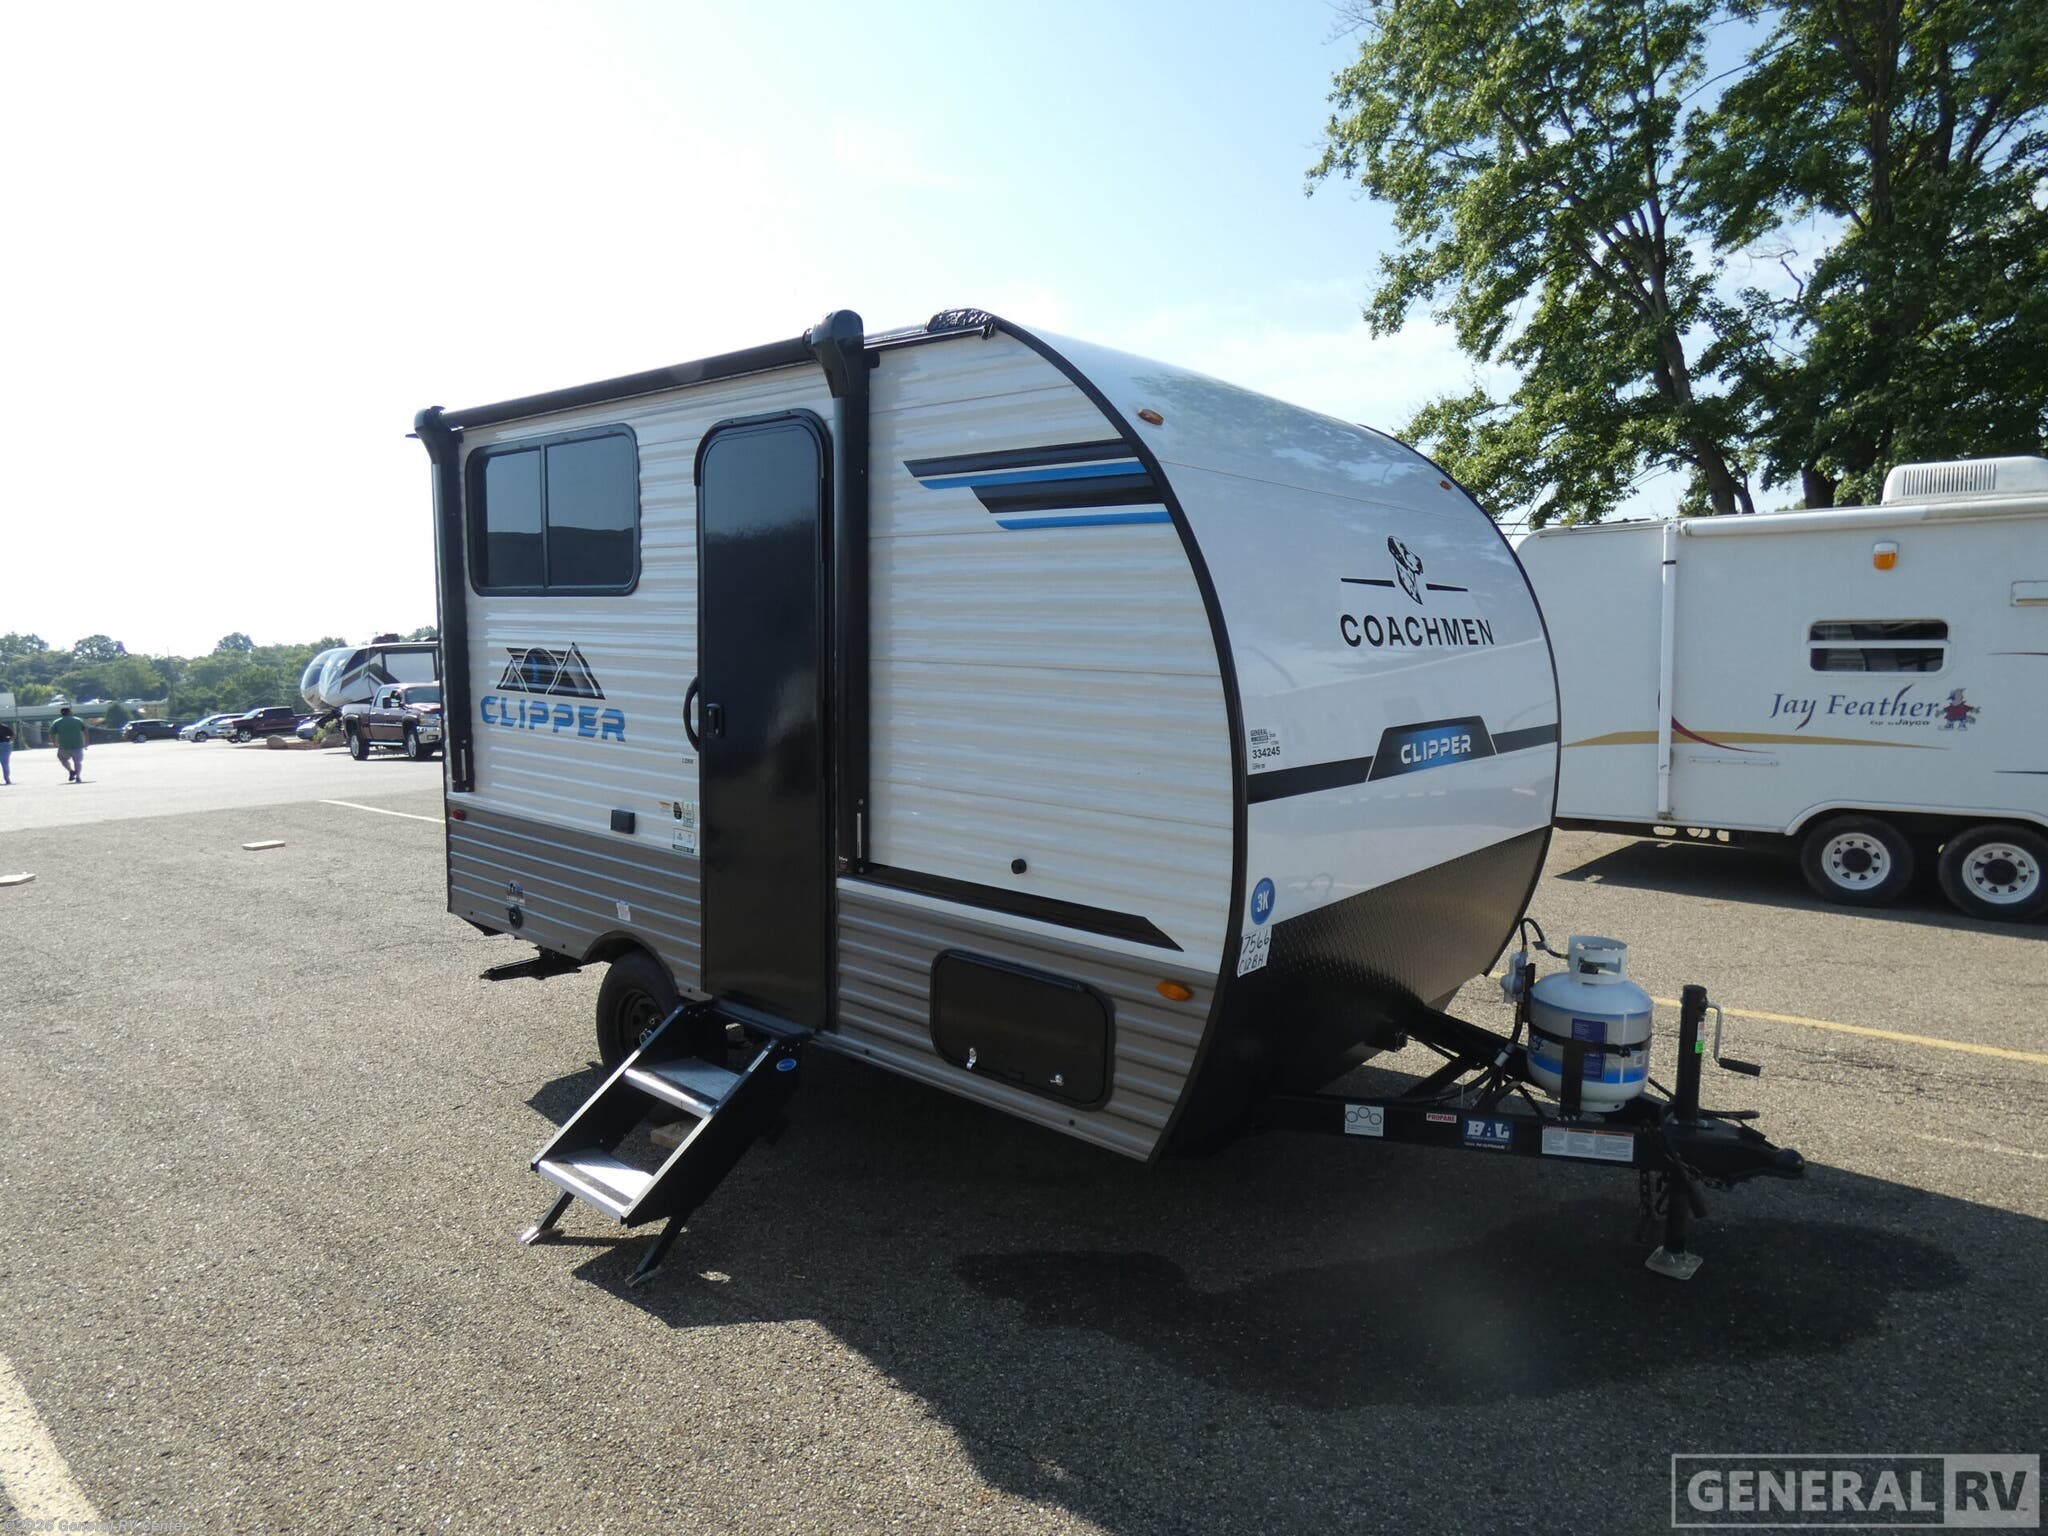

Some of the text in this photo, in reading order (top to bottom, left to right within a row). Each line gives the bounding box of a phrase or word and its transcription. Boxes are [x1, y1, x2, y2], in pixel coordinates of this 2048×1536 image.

[1340, 614, 1495, 647] COACHMEN
[480, 695, 626, 742] CLIPPER
[1769, 684, 1939, 731] Jay Feather
[1252, 746, 1281, 759] 334245
[1401, 734, 1472, 765] CLIPPER
[1257, 890, 1270, 913] 3K
[1242, 929, 1270, 954] 7566
